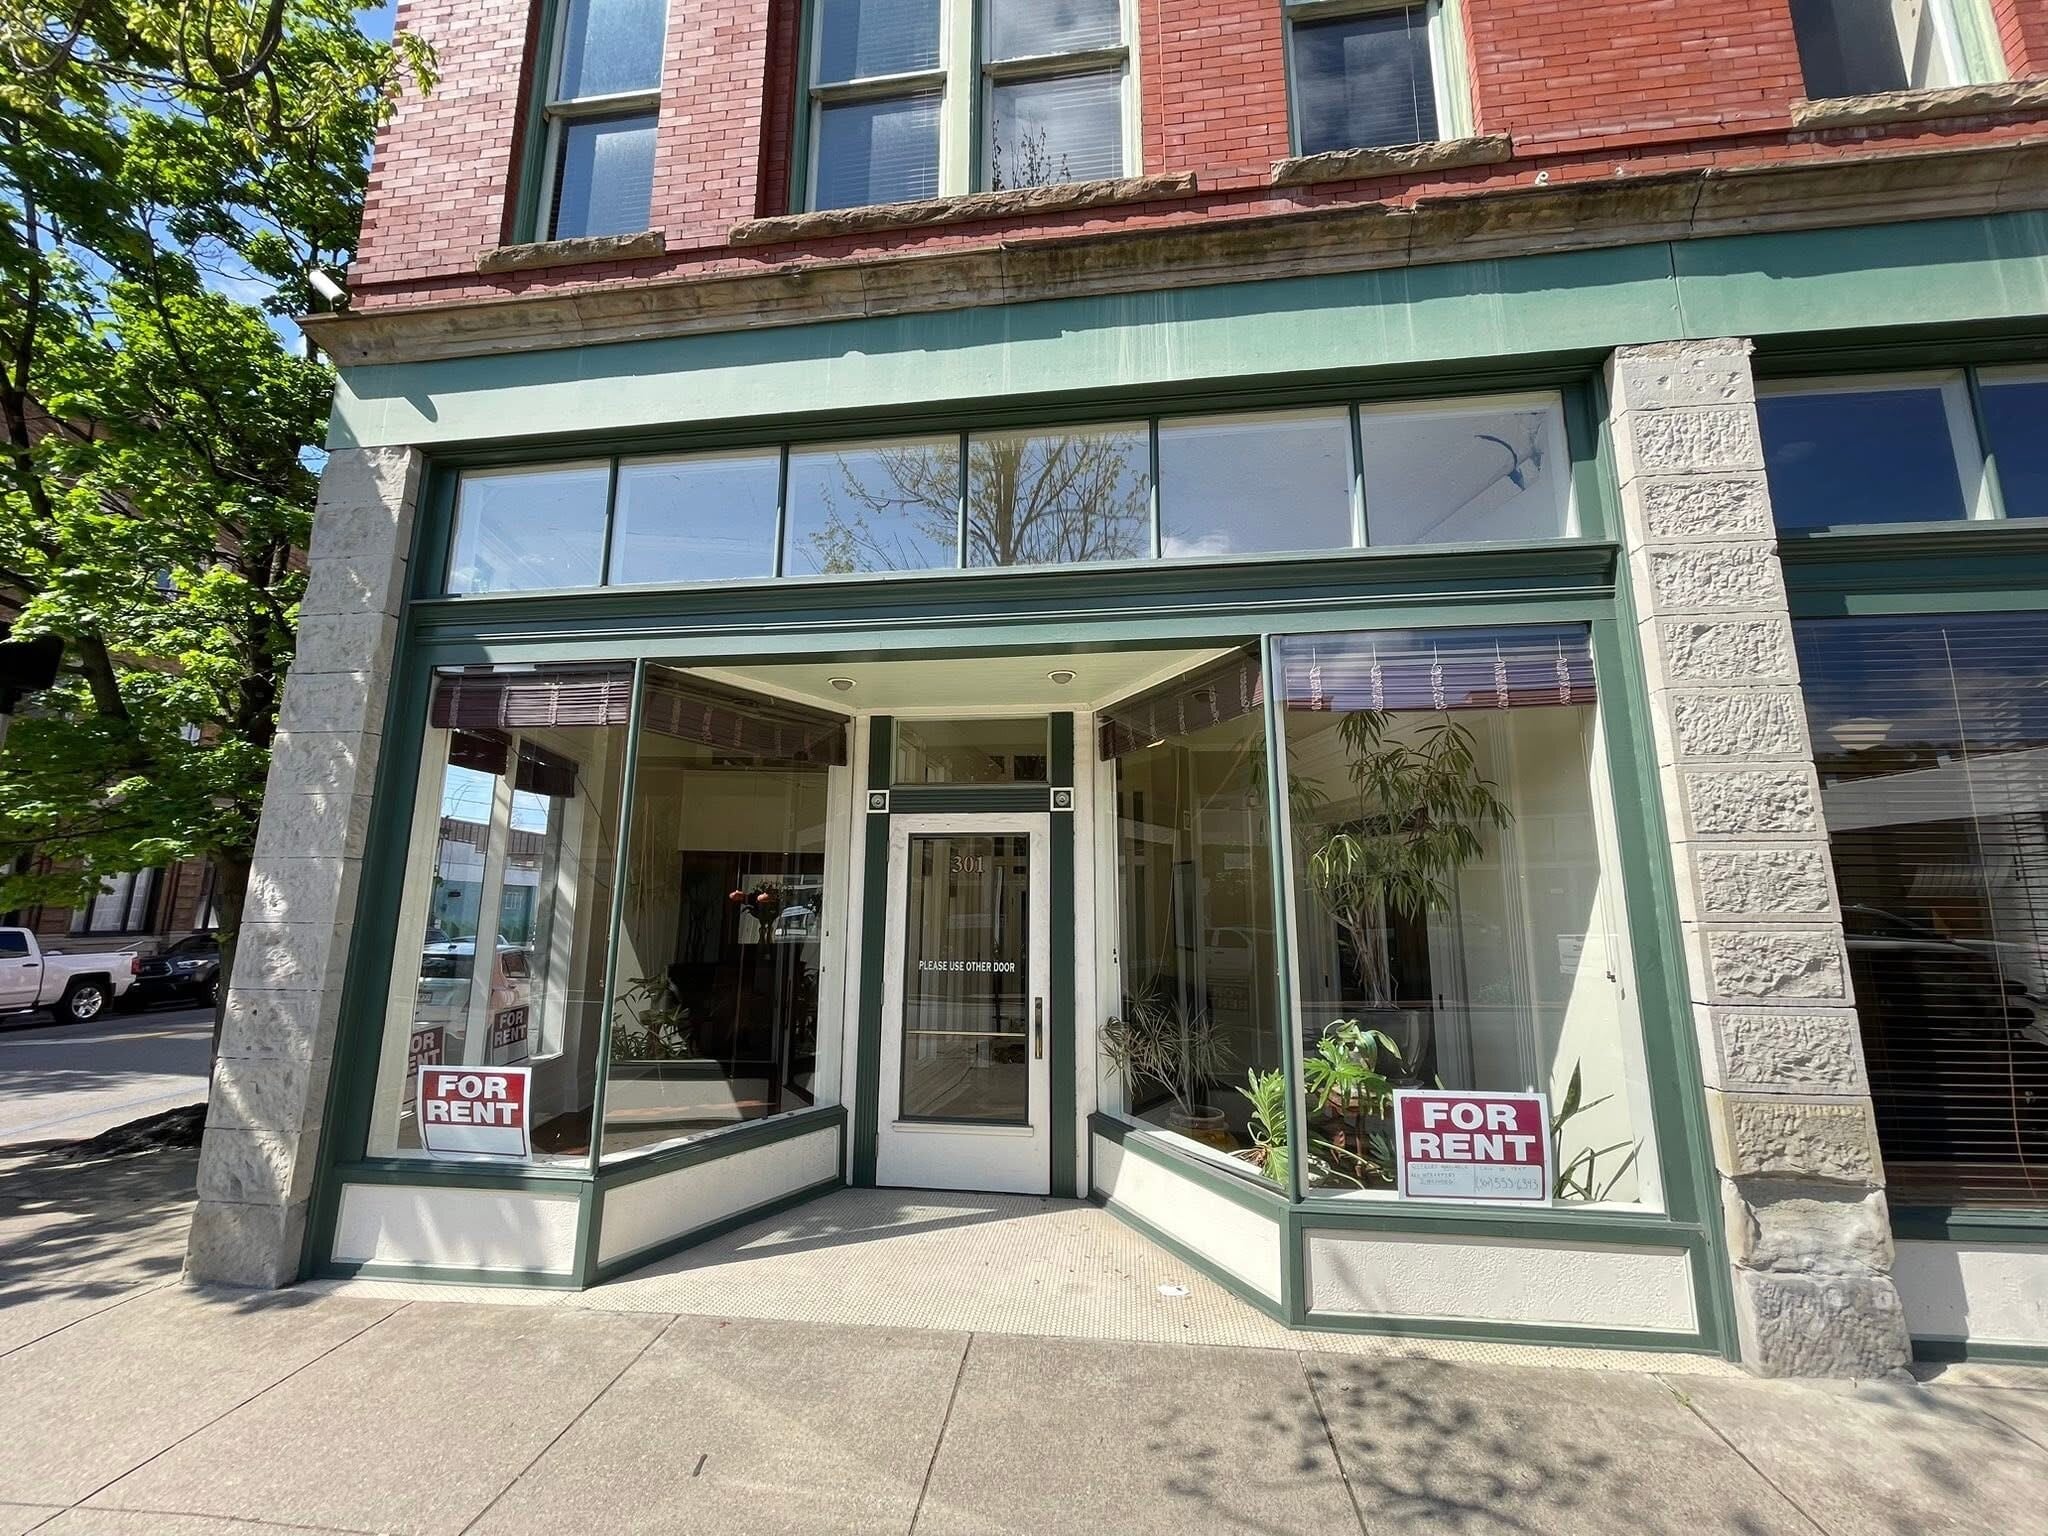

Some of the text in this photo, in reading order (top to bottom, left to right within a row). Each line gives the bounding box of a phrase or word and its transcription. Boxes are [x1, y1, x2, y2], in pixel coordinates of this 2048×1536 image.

[951, 856, 985, 873] 301
[918, 960, 1015, 973] PLEASE USE OTHER DOOR
[499, 1010, 524, 1029] FOR
[411, 1032, 435, 1053] OR
[494, 1024, 528, 1048] RENT
[408, 1048, 441, 1074] ENT
[437, 1074, 508, 1100] FOR
[426, 1100, 518, 1125] RENT
[1422, 1102, 1518, 1131] FOR
[1410, 1132, 1536, 1162] RENT
